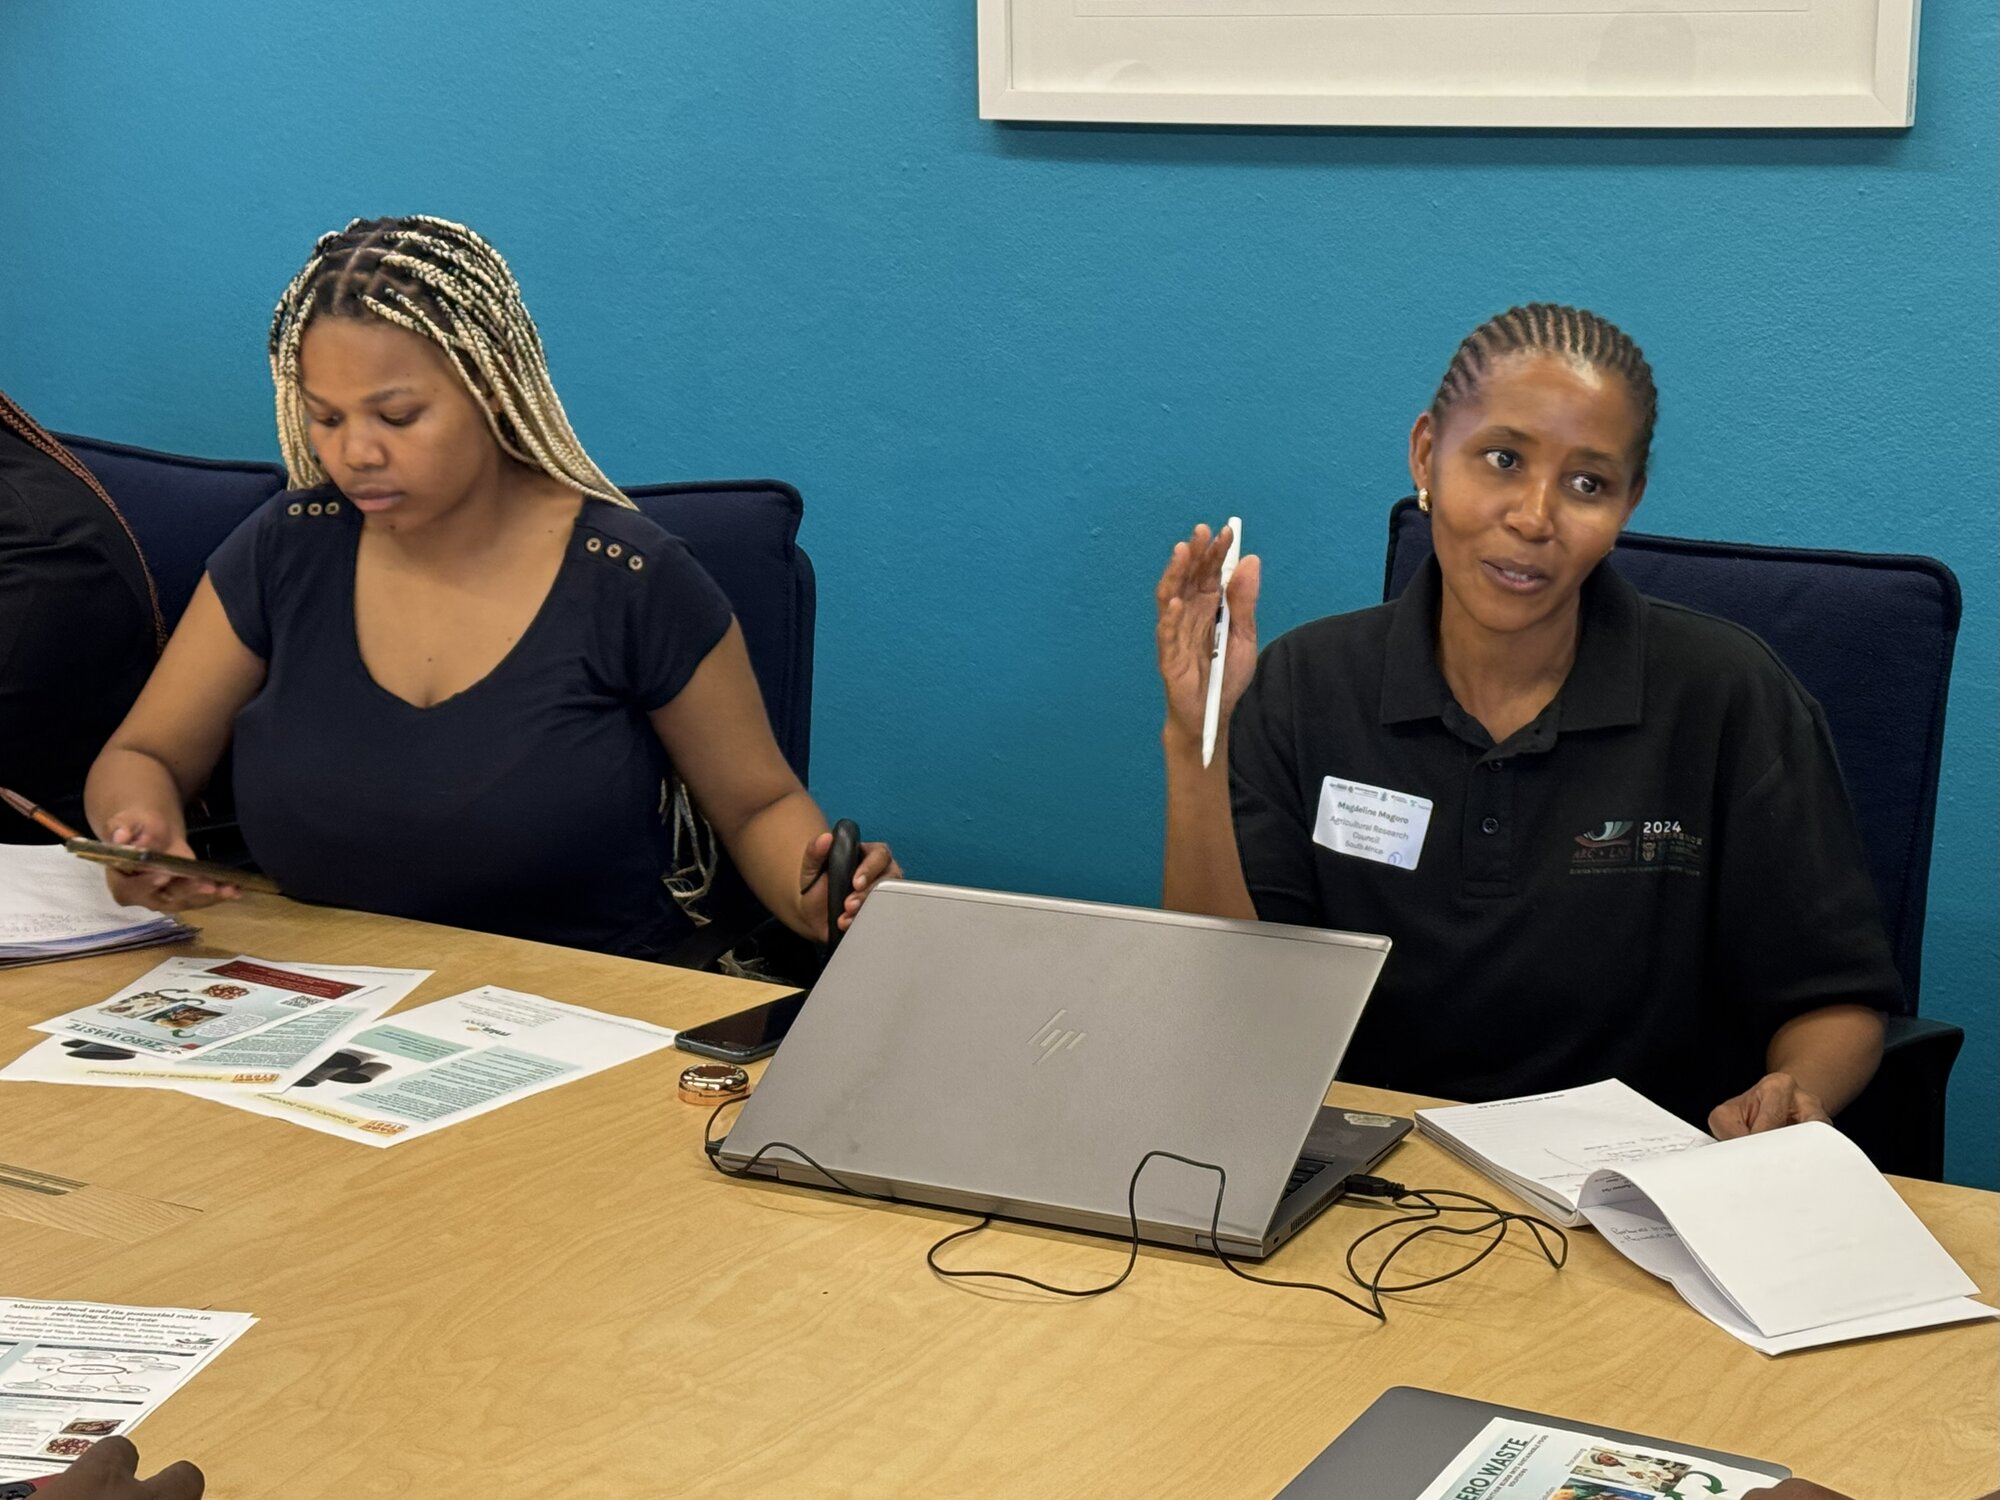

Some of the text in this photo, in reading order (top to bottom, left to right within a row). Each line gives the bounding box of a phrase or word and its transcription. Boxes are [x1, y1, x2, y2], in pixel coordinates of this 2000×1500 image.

[1337, 801, 1409, 824] Magdeline Magoro
[1330, 815, 1409, 840] Agricultural Research
[1643, 821, 1682, 834] 2024
[1352, 831, 1381, 844] Council
[1345, 840, 1384, 856] South Africa
[65, 1023, 119, 1040] WASTE
[120, 1034, 165, 1053] ZERO
[56, 1305, 88, 1313] blood
[88, 1307, 110, 1315] and
[126, 1310, 175, 1319] potential
[176, 1312, 200, 1320] role
[100, 1313, 127, 1321] food
[1455, 1438, 1528, 1500] ERO WASTE
